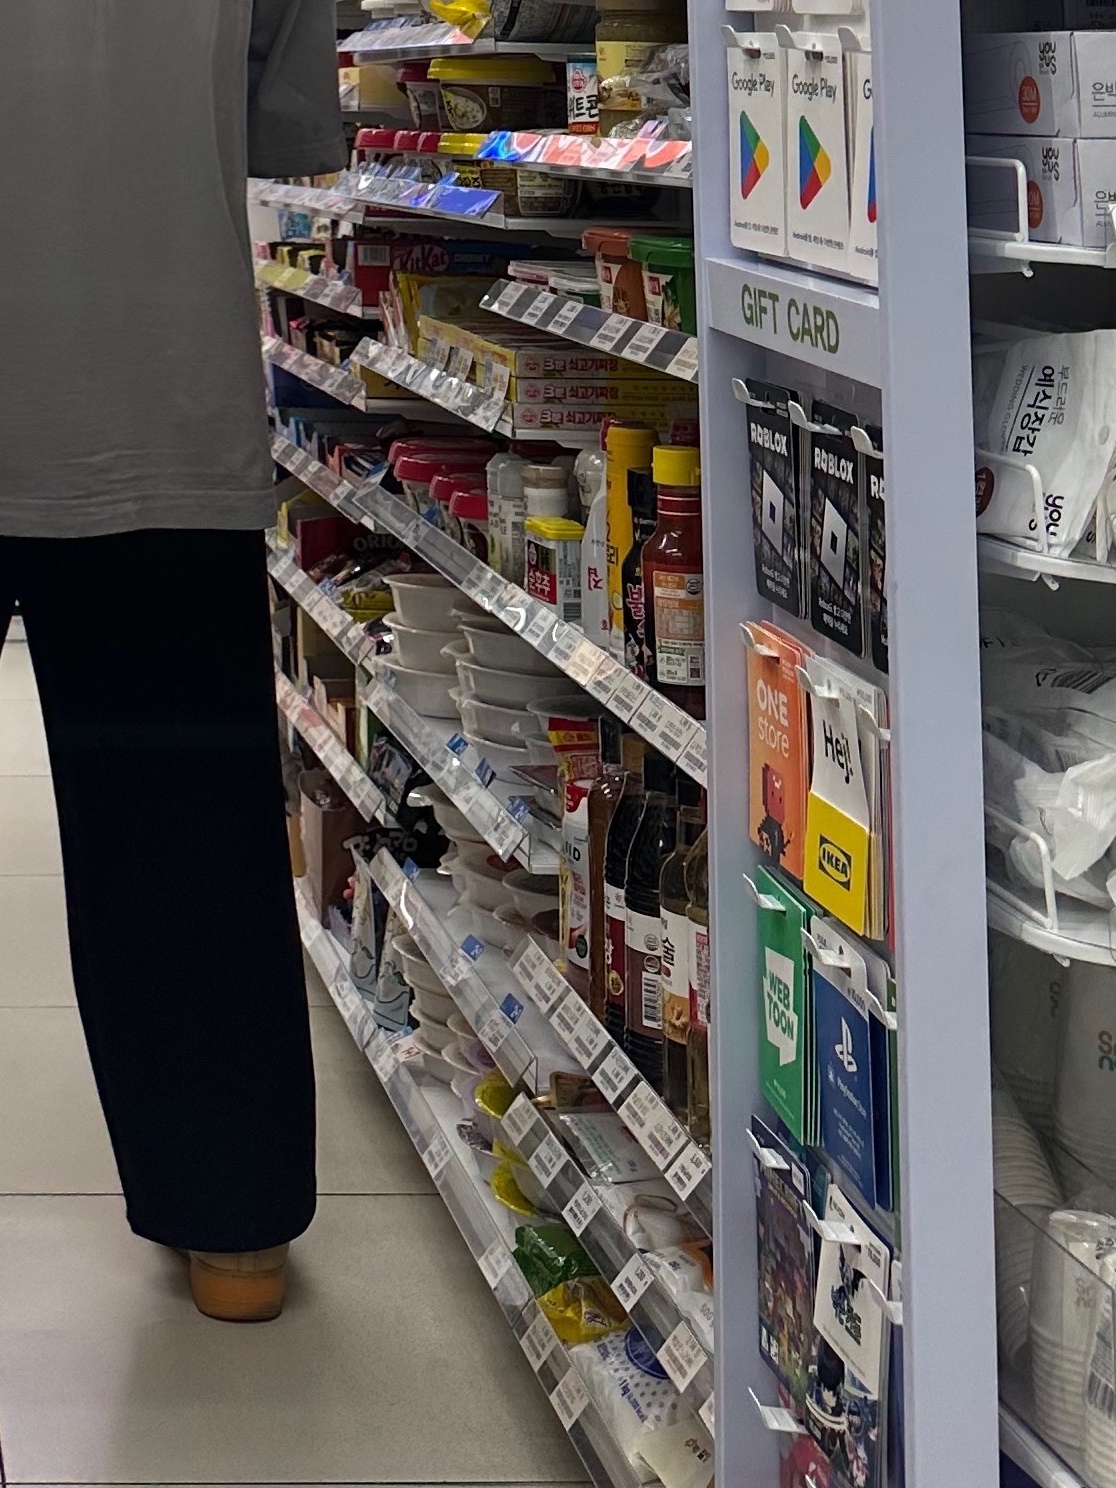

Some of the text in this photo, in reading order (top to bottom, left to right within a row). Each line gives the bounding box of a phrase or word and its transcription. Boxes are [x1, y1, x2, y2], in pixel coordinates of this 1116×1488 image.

[732, 72, 775, 97] Google Play
[792, 73, 820, 102] Google
[819, 77, 837, 104] Play
[741, 283, 840, 355] GIFT CARD
[1012, 365, 1055, 457] 예식장갑
[1047, 364, 1070, 426] 부드러운
[750, 422, 788, 457] ROBLOX
[814, 446, 854, 485] ROBLOX
[1044, 493, 1065, 537] you
[756, 679, 789, 727] ONE
[758, 715, 790, 758] store
[822, 718, 854, 785] Hej!
[822, 848, 848, 879] IKEA
[768, 969, 791, 1008] WEB
[767, 995, 795, 1041] TOON
